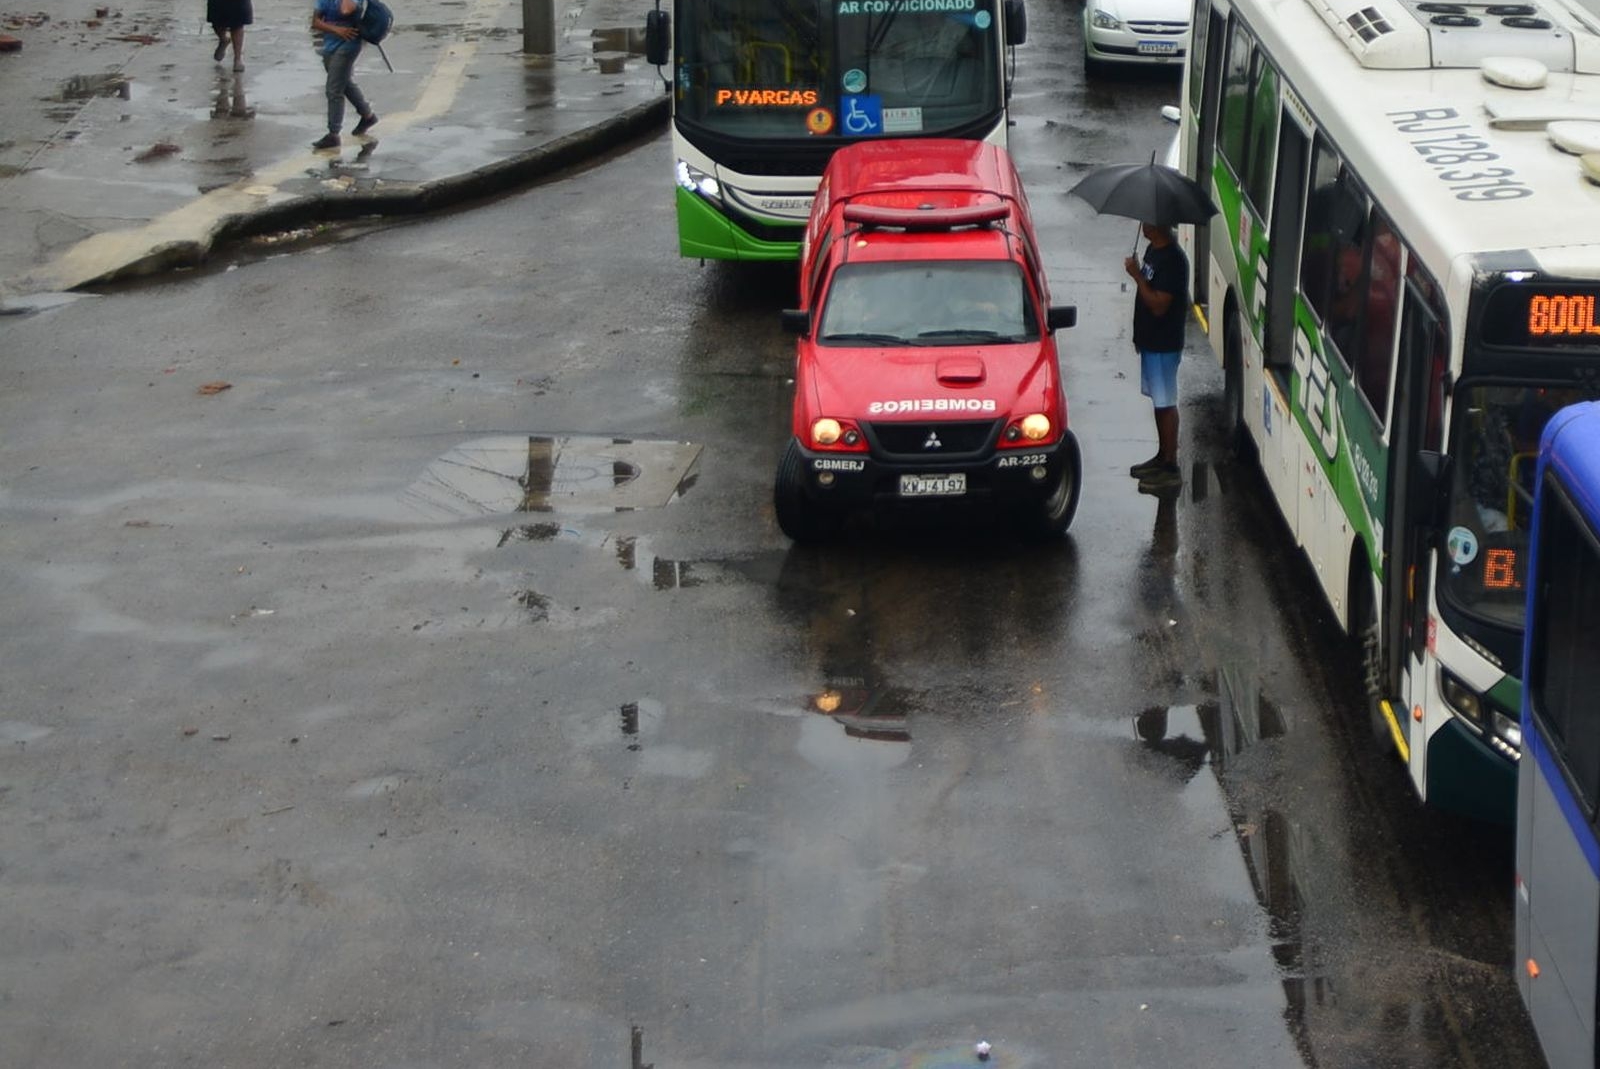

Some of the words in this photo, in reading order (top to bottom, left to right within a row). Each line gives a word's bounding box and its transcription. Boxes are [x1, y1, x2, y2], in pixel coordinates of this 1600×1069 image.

[839, 1, 860, 14] AR
[716, 89, 818, 106] P.VARGAS
[814, 458, 865, 471] CBMERJ
[998, 454, 1048, 468] AR-222
